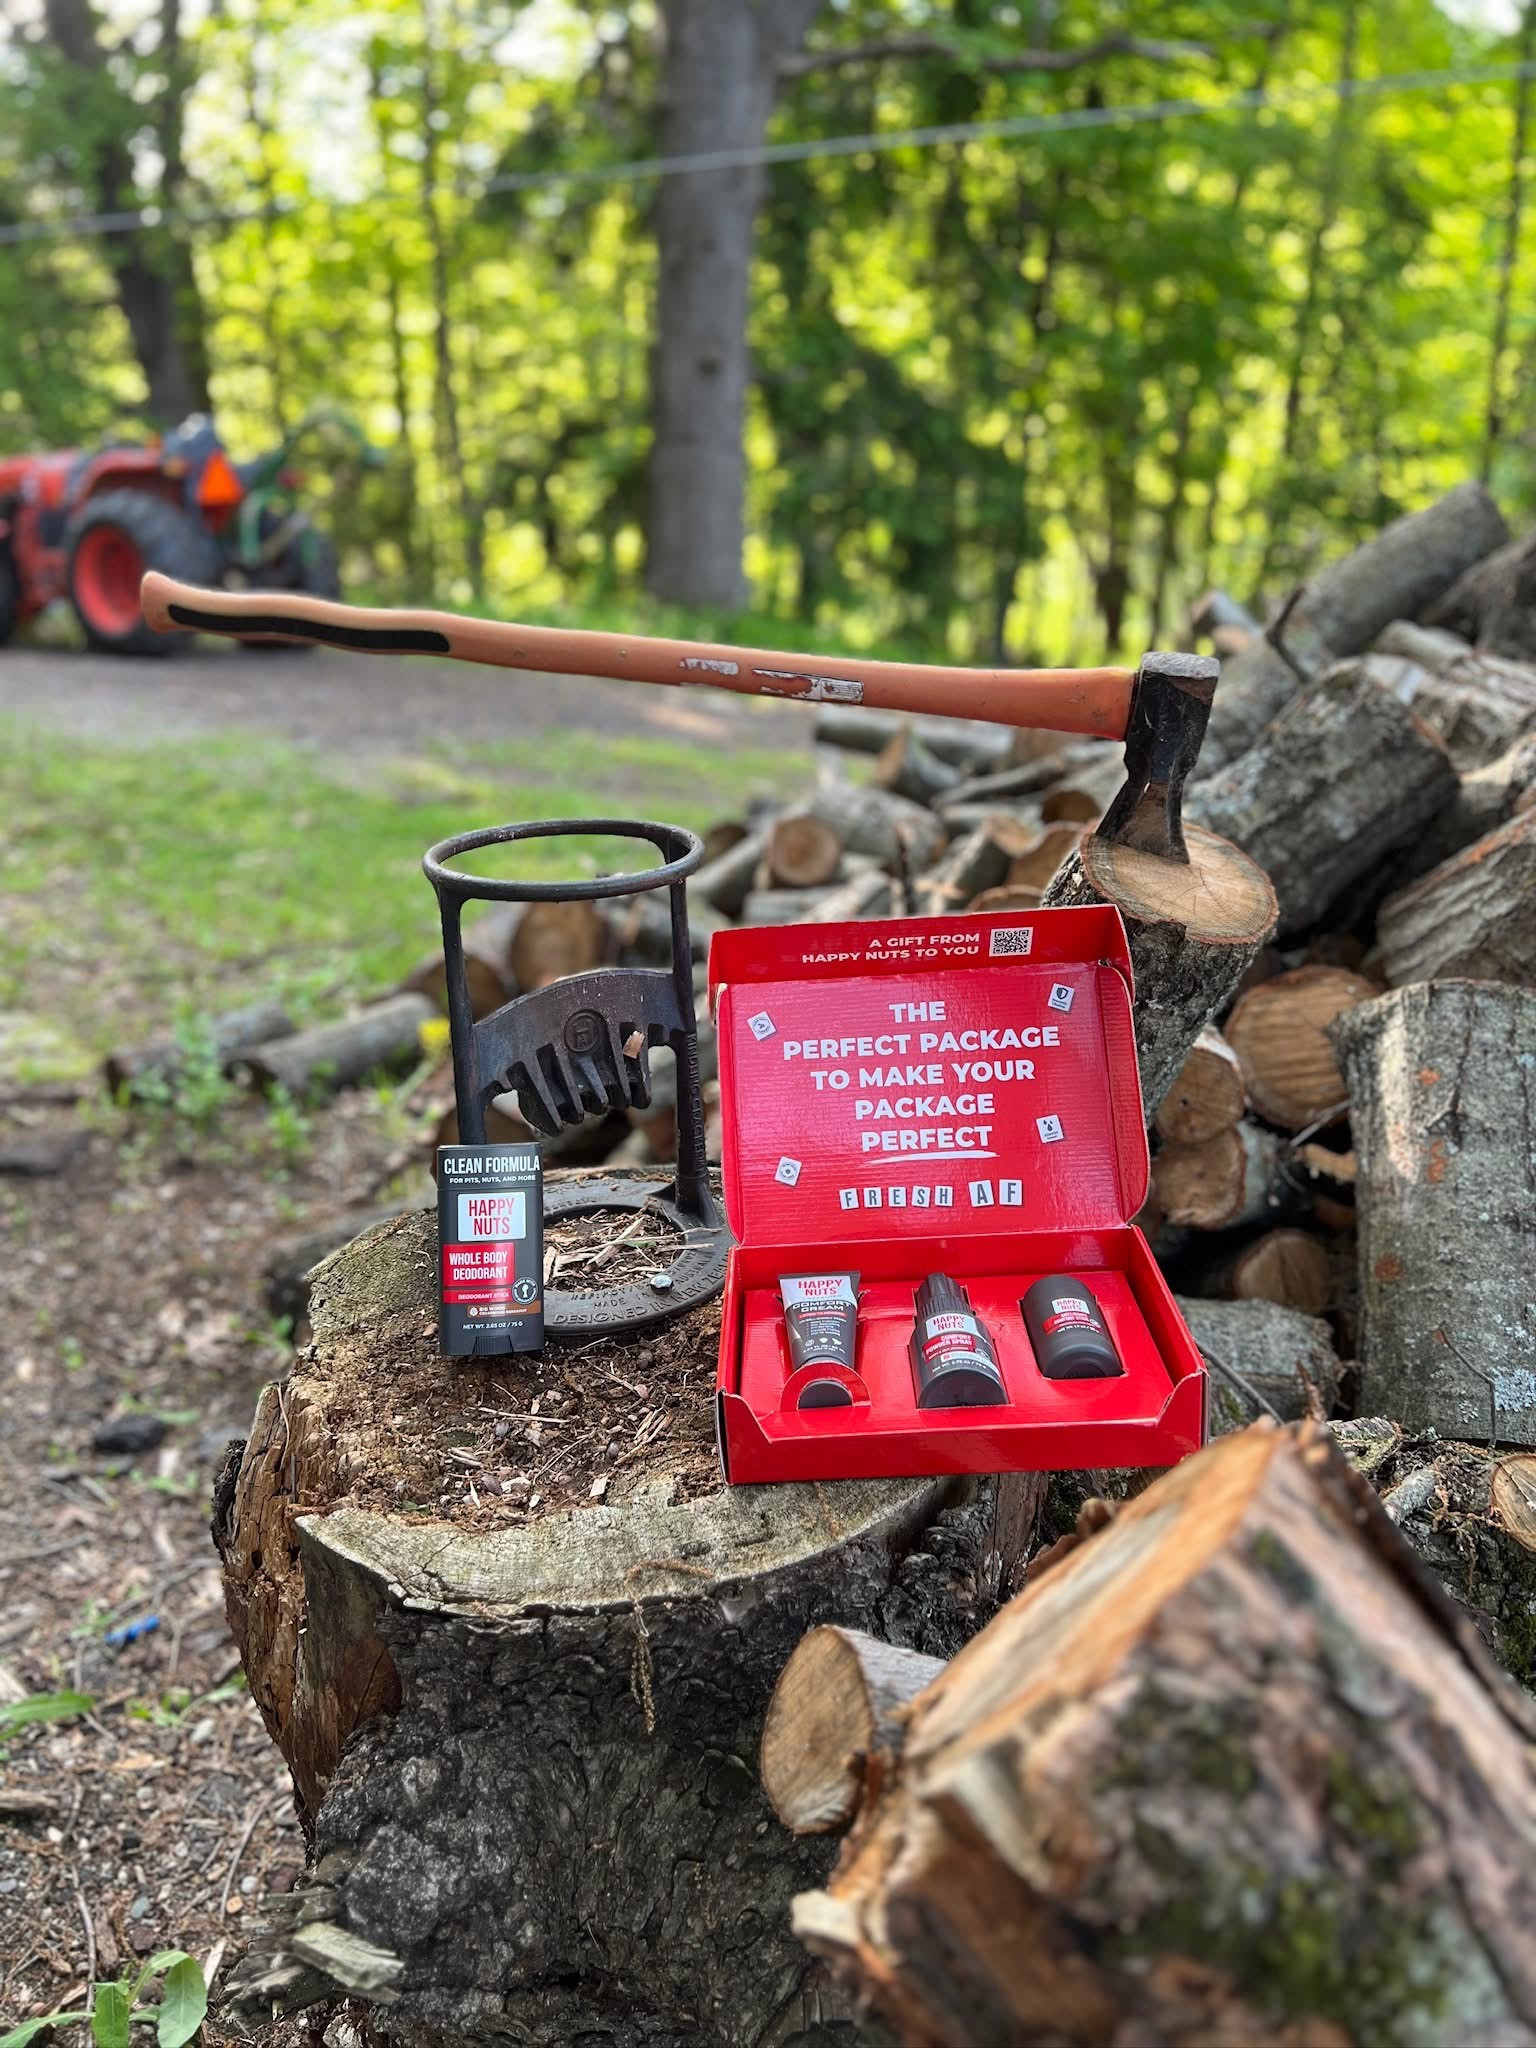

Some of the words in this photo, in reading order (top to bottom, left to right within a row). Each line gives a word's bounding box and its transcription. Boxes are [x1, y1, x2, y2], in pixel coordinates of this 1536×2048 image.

[869, 938, 882, 948] A
[886, 935, 927, 948] GIFT
[929, 932, 980, 945] FROM
[802, 952, 860, 964] HAPPY
[865, 949, 912, 961] NUTS
[915, 948, 939, 959] TO
[943, 945, 980, 957] YOU
[888, 1000, 947, 1024] THE
[783, 1034, 912, 1060] PERFECT
[920, 1025, 1061, 1054] PACKAGE
[810, 1070, 850, 1091] TO
[859, 1063, 945, 1089] MAKE
[950, 1059, 1036, 1083] YOUR
[855, 1093, 996, 1120] PACKAGE
[861, 1125, 993, 1152] PERFECT
[443, 1157, 484, 1175] CLEAN
[485, 1155, 541, 1173] FORMULA
[464, 1176, 481, 1184] PITS,
[843, 1187, 950, 1209] FRESH
[976, 1182, 1017, 1205] AF
[468, 1198, 515, 1217] HAPPY
[472, 1217, 511, 1236] NUTS
[449, 1253, 482, 1266] WHOLE
[483, 1251, 509, 1264] BODY
[453, 1266, 509, 1281] DEODORANT
[798, 1279, 843, 1289] HAPPY
[805, 1287, 838, 1297] NUTS
[792, 1299, 852, 1310] COMFORT
[552, 1305, 648, 1325] DESIGNED
[933, 1315, 965, 1325] HAPPY
[937, 1321, 965, 1331] NUTS
